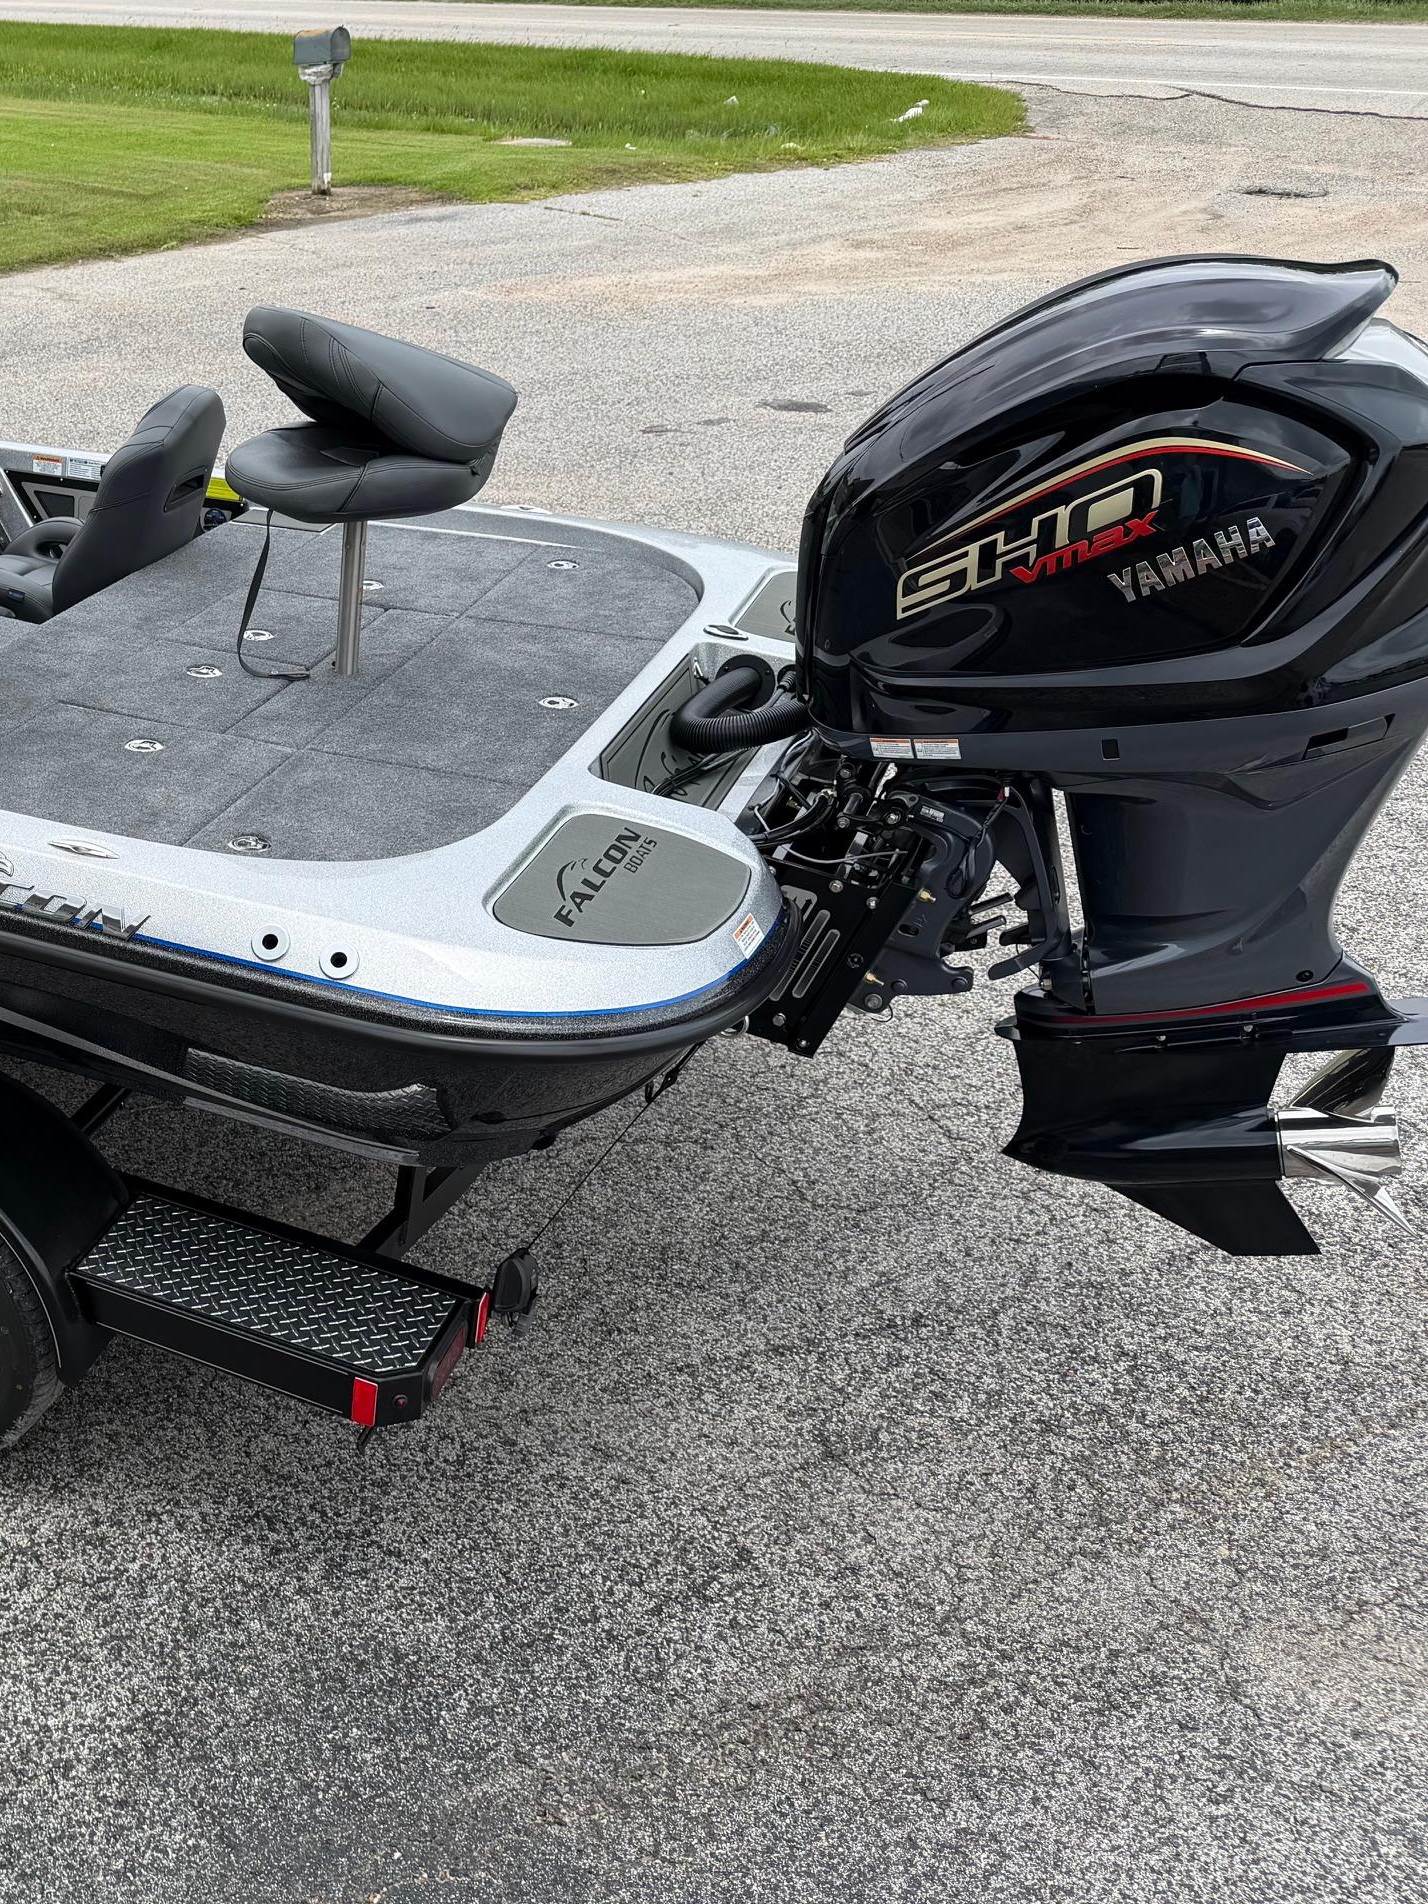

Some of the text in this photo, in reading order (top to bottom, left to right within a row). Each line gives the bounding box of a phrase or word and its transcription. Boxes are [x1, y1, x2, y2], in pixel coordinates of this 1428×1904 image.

[897, 469, 1163, 620] SHO
[1107, 516, 1275, 602] YAMAHA
[553, 826, 642, 928] FALCON
[623, 836, 658, 874] BOATS
